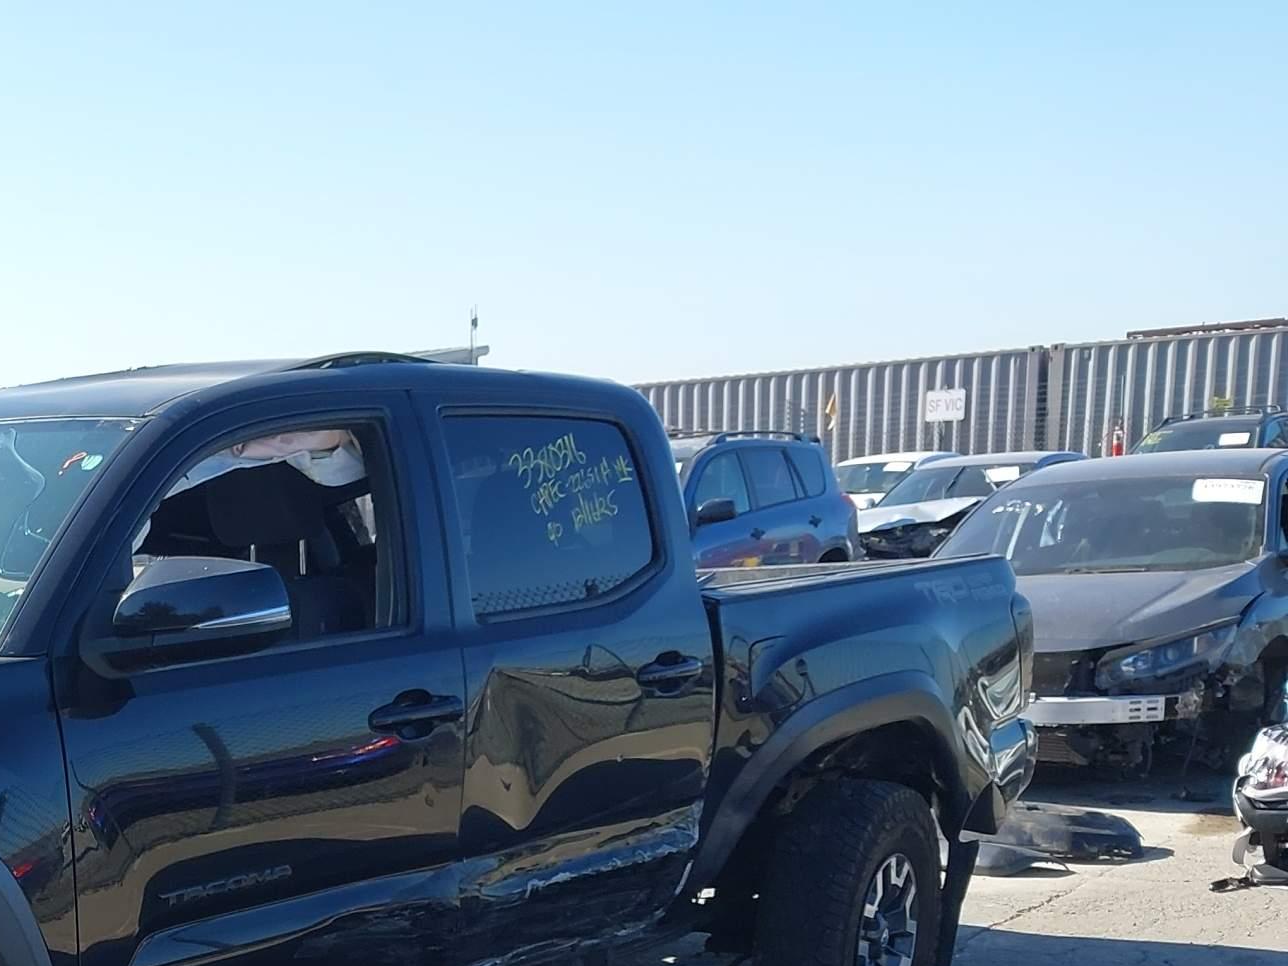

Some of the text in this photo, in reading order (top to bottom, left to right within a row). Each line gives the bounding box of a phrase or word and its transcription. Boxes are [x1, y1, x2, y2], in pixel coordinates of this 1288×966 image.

[928, 397, 963, 413] SF VIC
[158, 864, 293, 907] TACOMA
